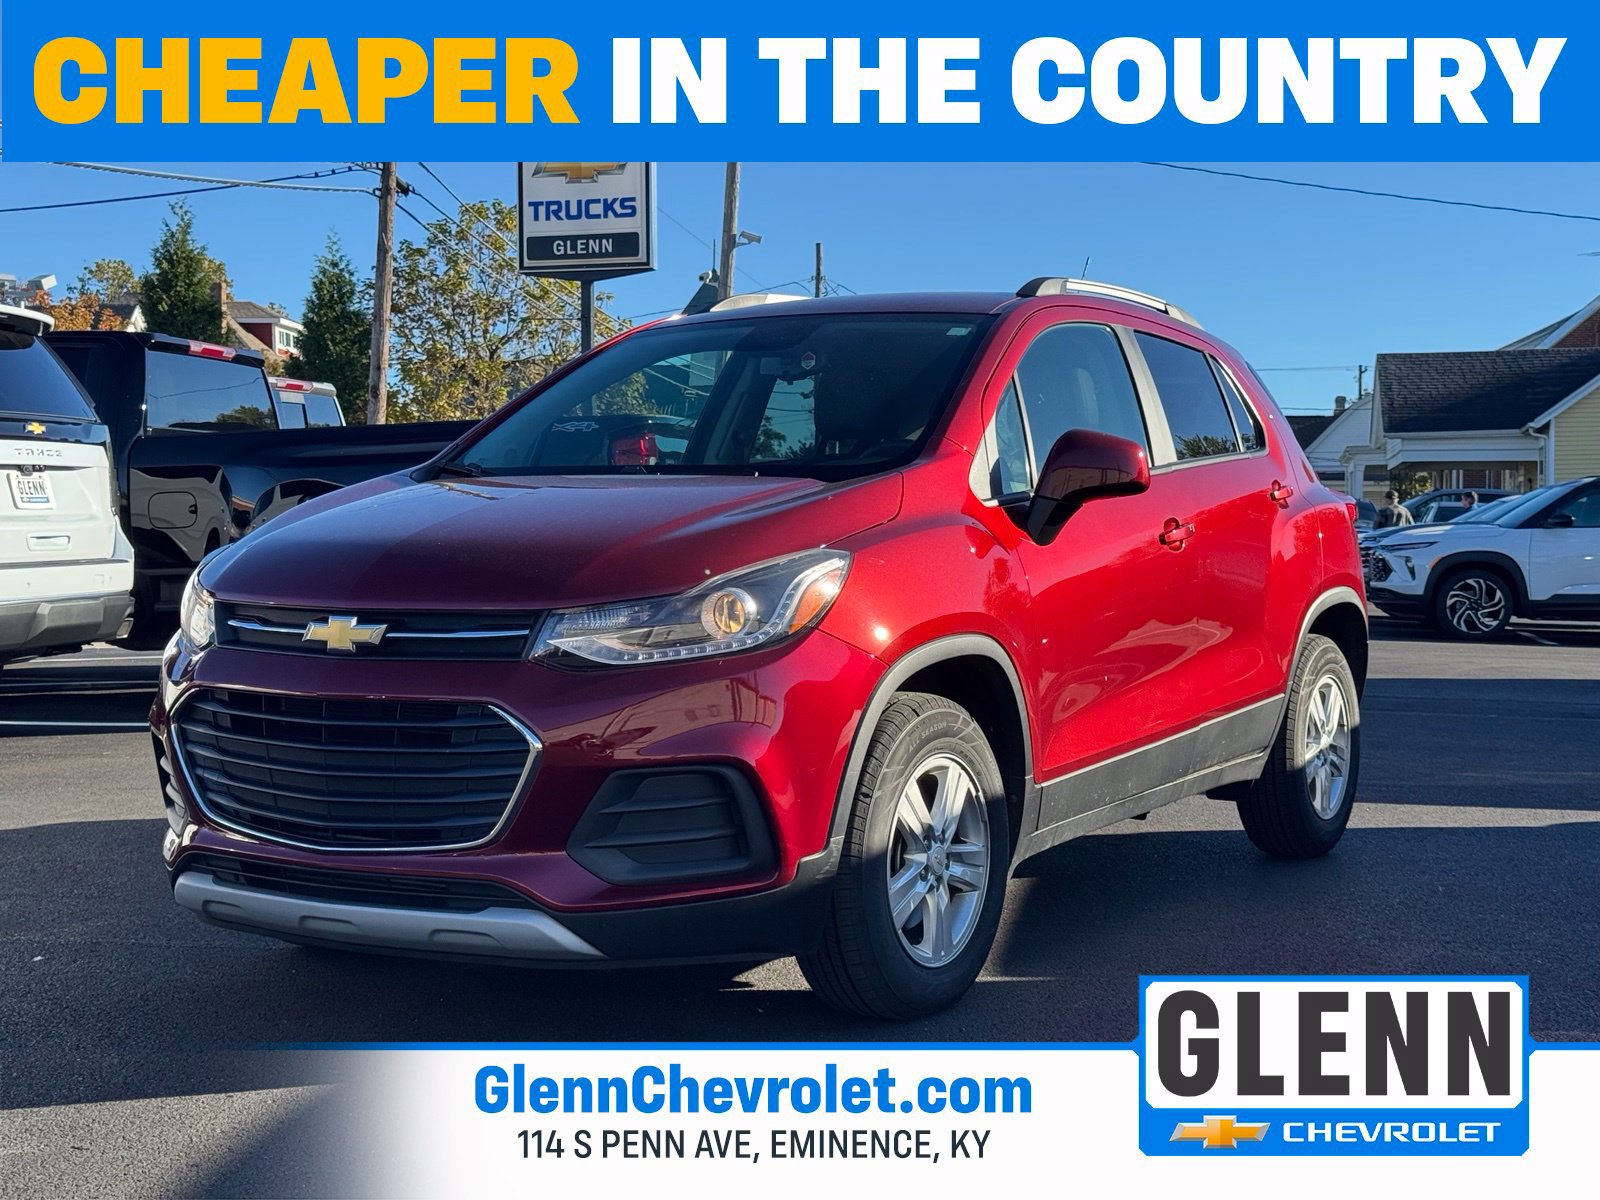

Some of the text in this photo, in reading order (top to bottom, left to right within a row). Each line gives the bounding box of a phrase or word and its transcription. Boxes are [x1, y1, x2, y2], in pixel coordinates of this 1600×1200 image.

[527, 196, 638, 222] TRUCKS
[552, 238, 613, 256] GLENN
[17, 480, 47, 495] GLENN
